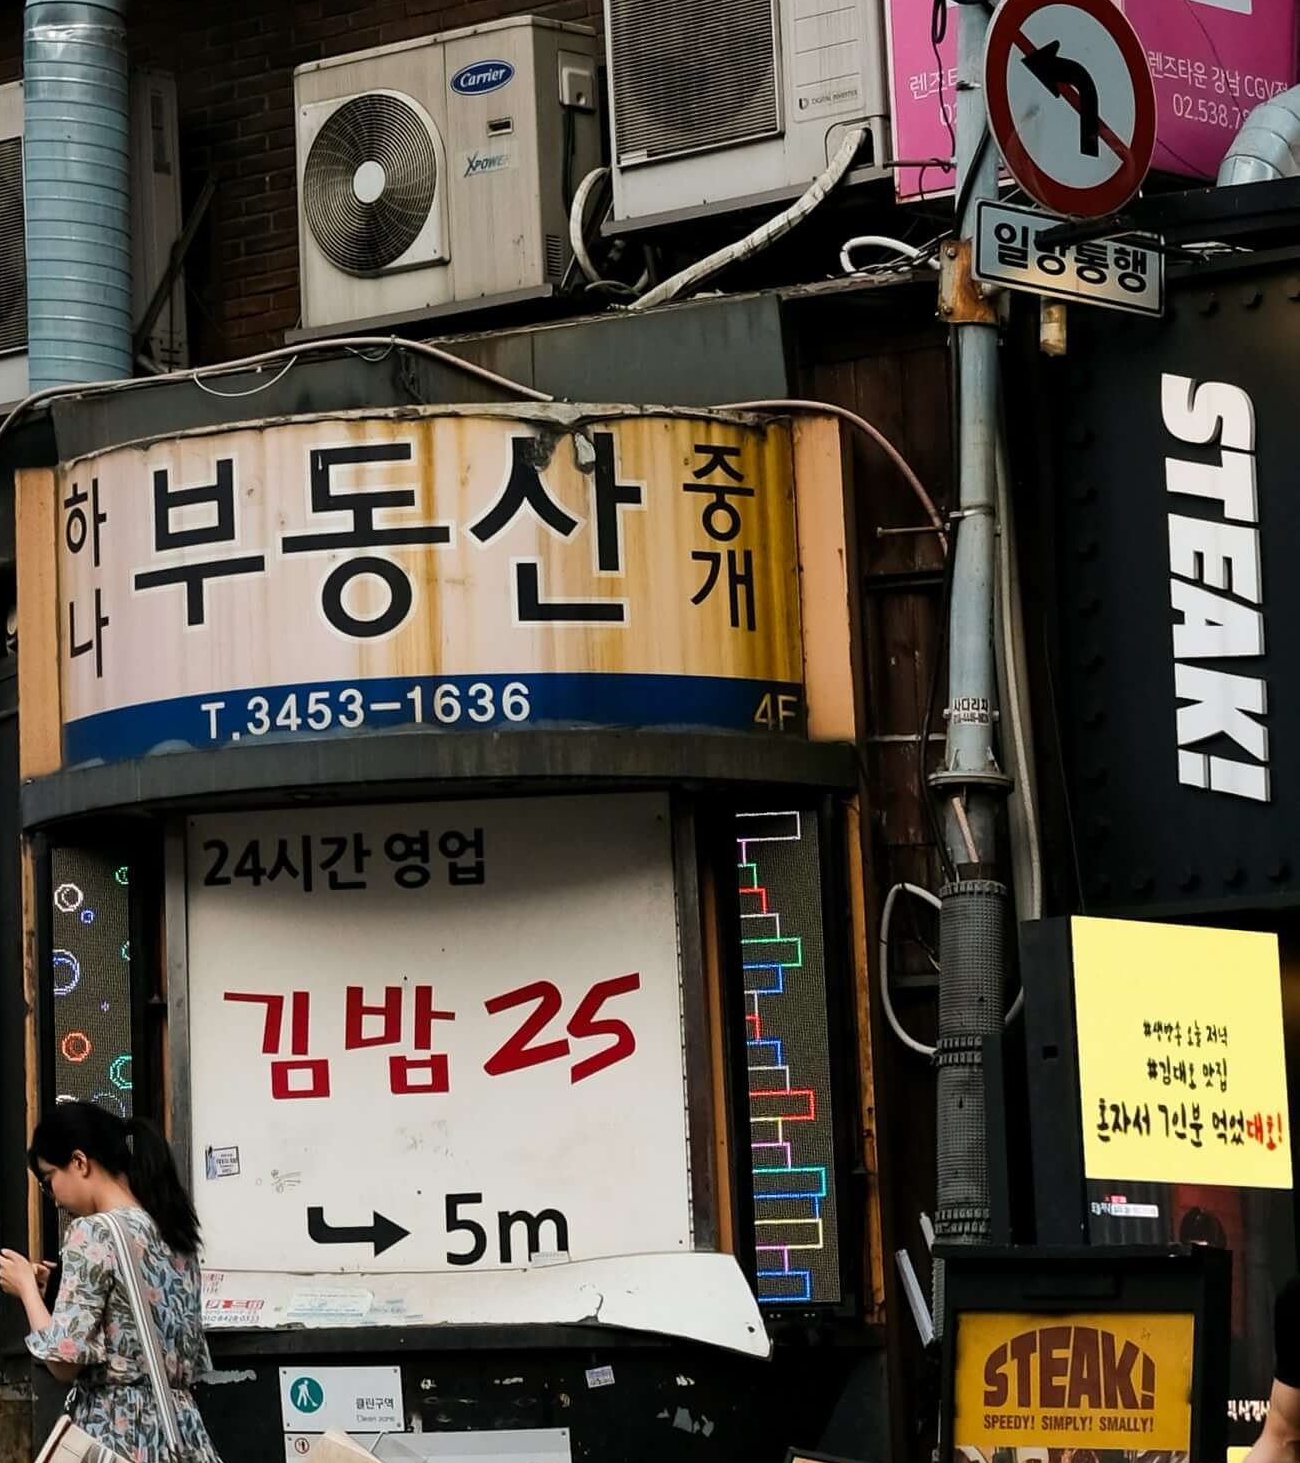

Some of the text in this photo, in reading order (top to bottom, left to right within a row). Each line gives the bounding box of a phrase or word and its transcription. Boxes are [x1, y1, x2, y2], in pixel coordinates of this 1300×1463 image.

[459, 65, 506, 89] Carrier
[1148, 49, 1241, 98] 렌즈타운 강남
[132, 429, 647, 643] 부동산
[680, 442, 758, 634] 중개
[62, 480, 110, 679] 하나
[1159, 370, 1270, 805] STEAK!
[199, 680, 532, 742] T.3453-1636
[202, 827, 488, 893] 24시간 영업
[222, 971, 642, 1101] 김밥 25
[1142, 1018, 1229, 1048] #생방송 오늘 저녁
[1146, 1054, 1228, 1093] #김대호 맛집
[1096, 1097, 1151, 1143] 혼자서
[1157, 1102, 1205, 1148] 7인분
[444, 1191, 570, 1266] 5m
[983, 1325, 1156, 1411] STEAK!
[355, 1396, 396, 1412] 클린구역
[983, 1413, 1155, 1433] SPEEDY! SIMPLY! SMALLY!
